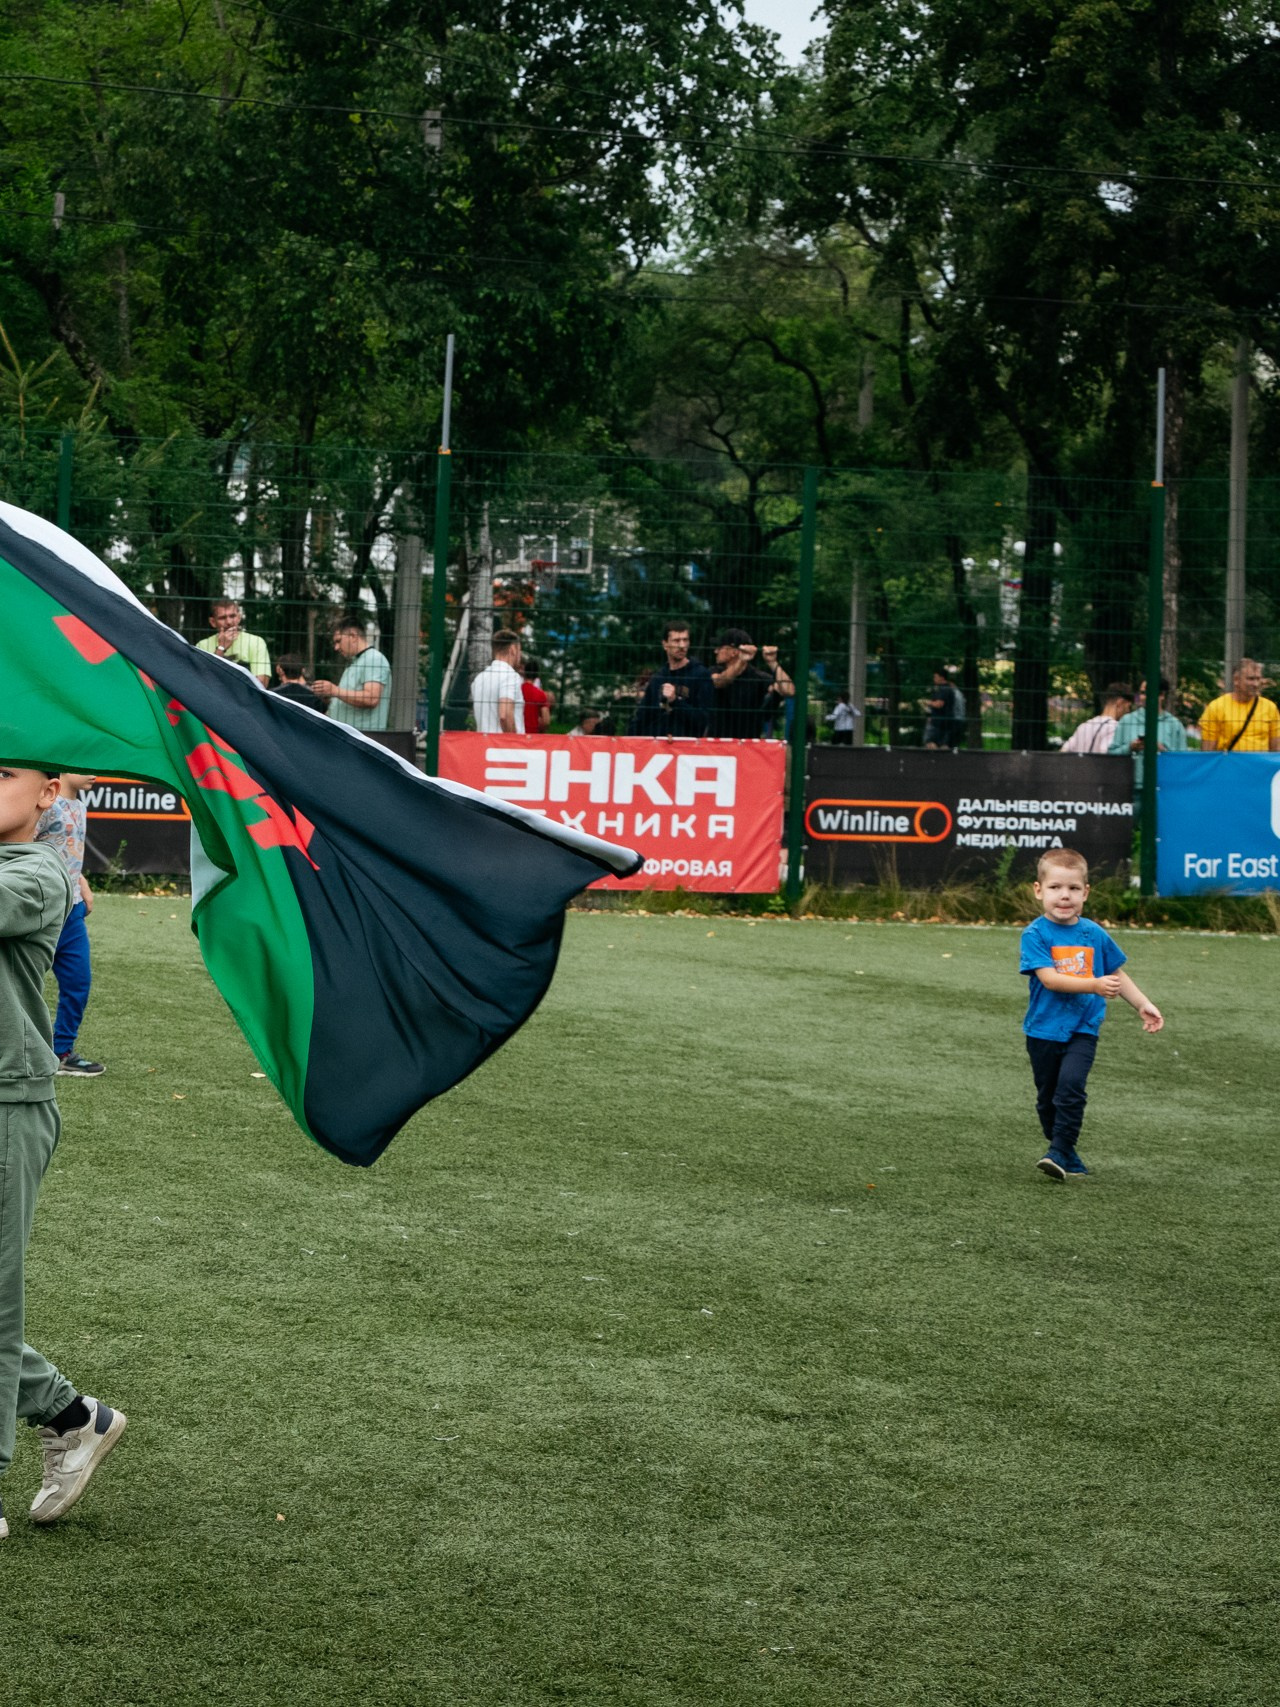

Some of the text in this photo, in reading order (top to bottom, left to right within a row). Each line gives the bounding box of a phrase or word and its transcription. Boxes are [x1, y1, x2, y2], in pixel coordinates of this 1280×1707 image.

[484, 748, 737, 807] ЭНКА
[79, 786, 176, 810] Winline
[957, 798, 1133, 816] ДАЛЬНЕВОСТОЧНАЯ
[818, 809, 910, 832] Winline
[957, 815, 1077, 831] ФУТБОЛЬНАЯ
[956, 834, 1063, 849] МЕДИАЛИГА
[638, 858, 732, 877] ФРОВАЯ
[1184, 853, 1279, 878] Far East
